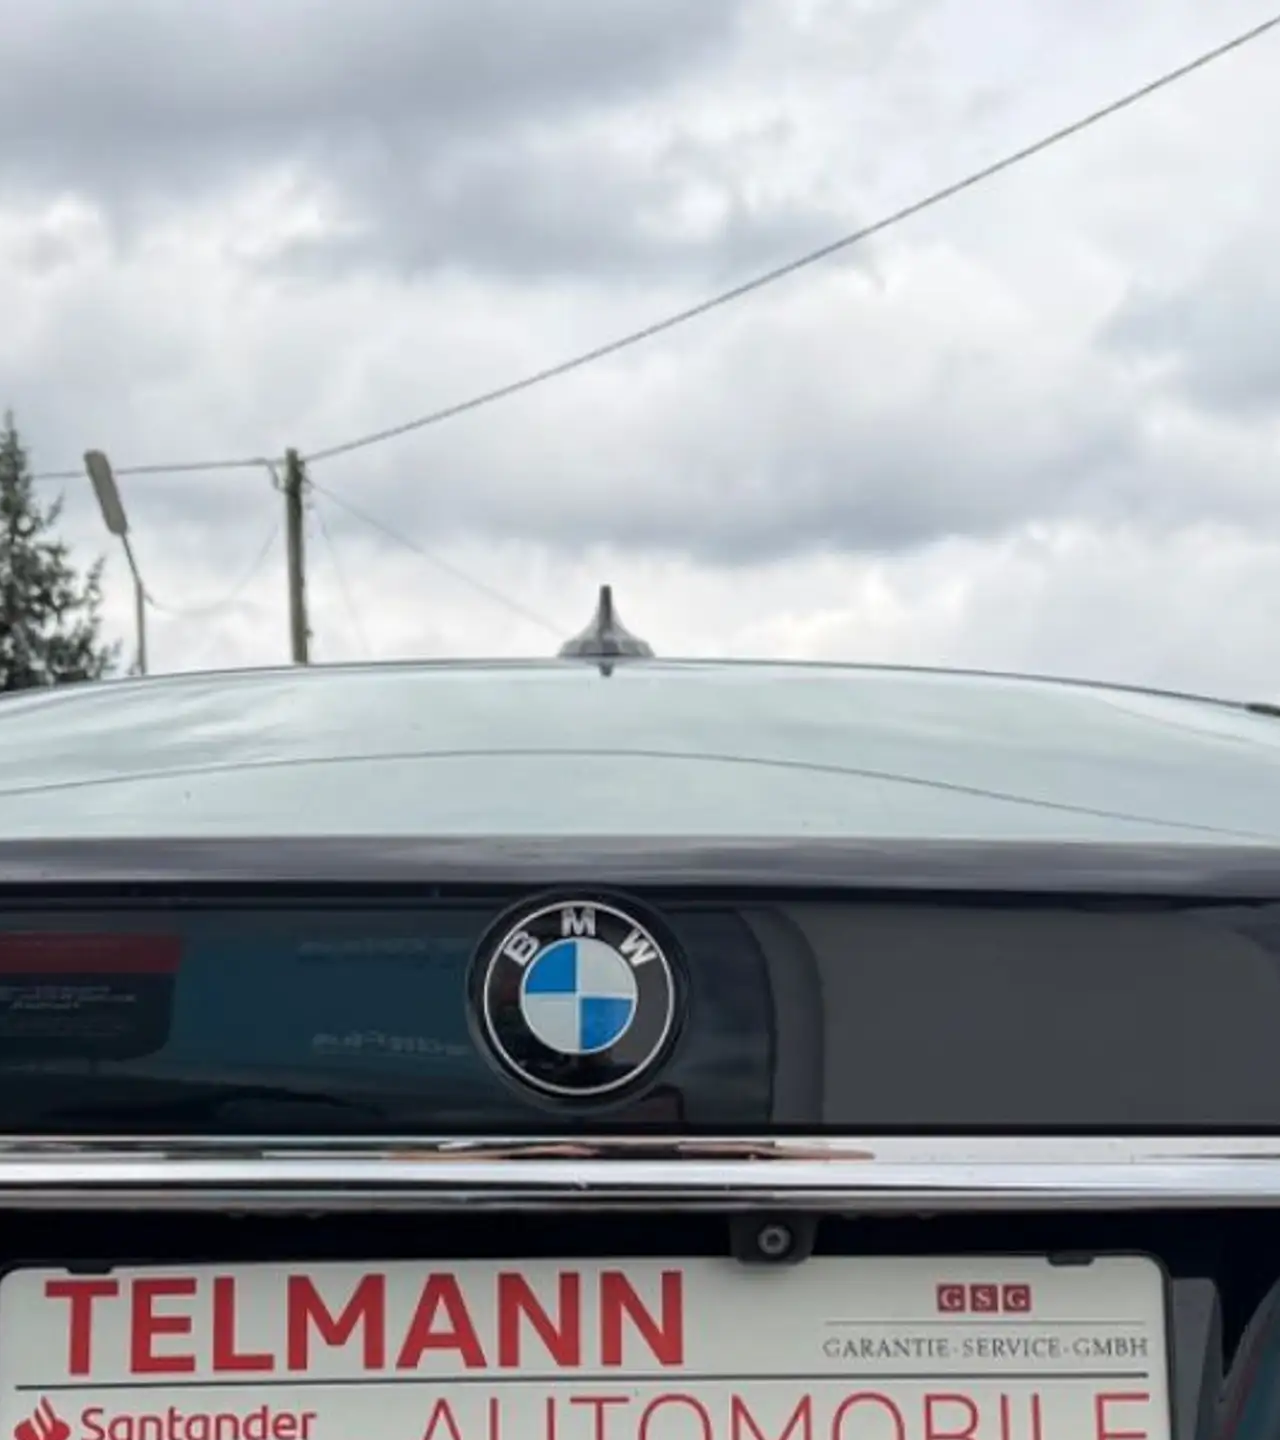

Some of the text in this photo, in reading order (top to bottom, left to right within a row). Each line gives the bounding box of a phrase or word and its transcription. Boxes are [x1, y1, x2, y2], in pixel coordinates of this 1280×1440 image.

[503, 907, 658, 967] BMW
[45, 1271, 684, 1376] TELMANN
[937, 1284, 1031, 1313] GSG
